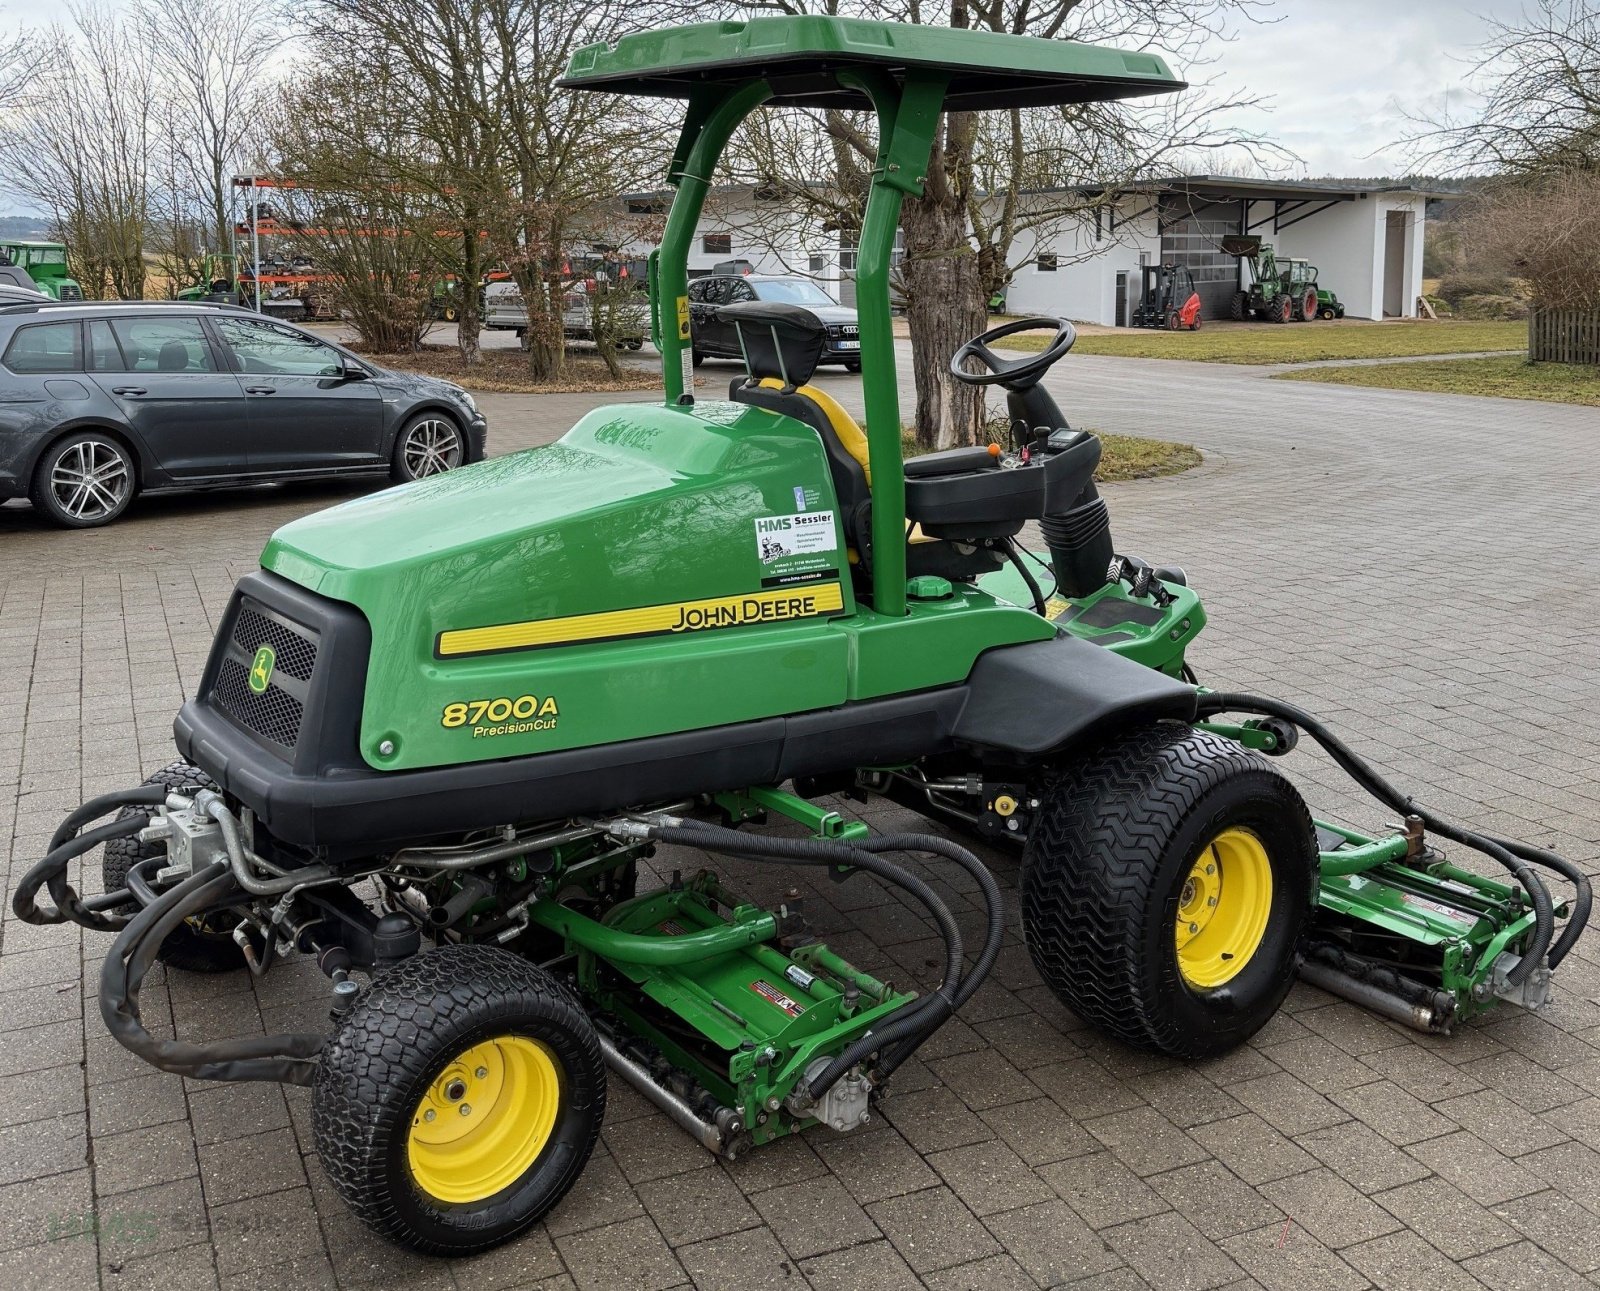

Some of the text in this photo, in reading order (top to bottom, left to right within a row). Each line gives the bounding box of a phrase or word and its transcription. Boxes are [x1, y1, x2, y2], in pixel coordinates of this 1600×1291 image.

[758, 518, 791, 532] HMS
[795, 515, 831, 525] Sessler
[671, 596, 817, 630] JOHN DEERE
[472, 718, 558, 738] PrecisionCut
